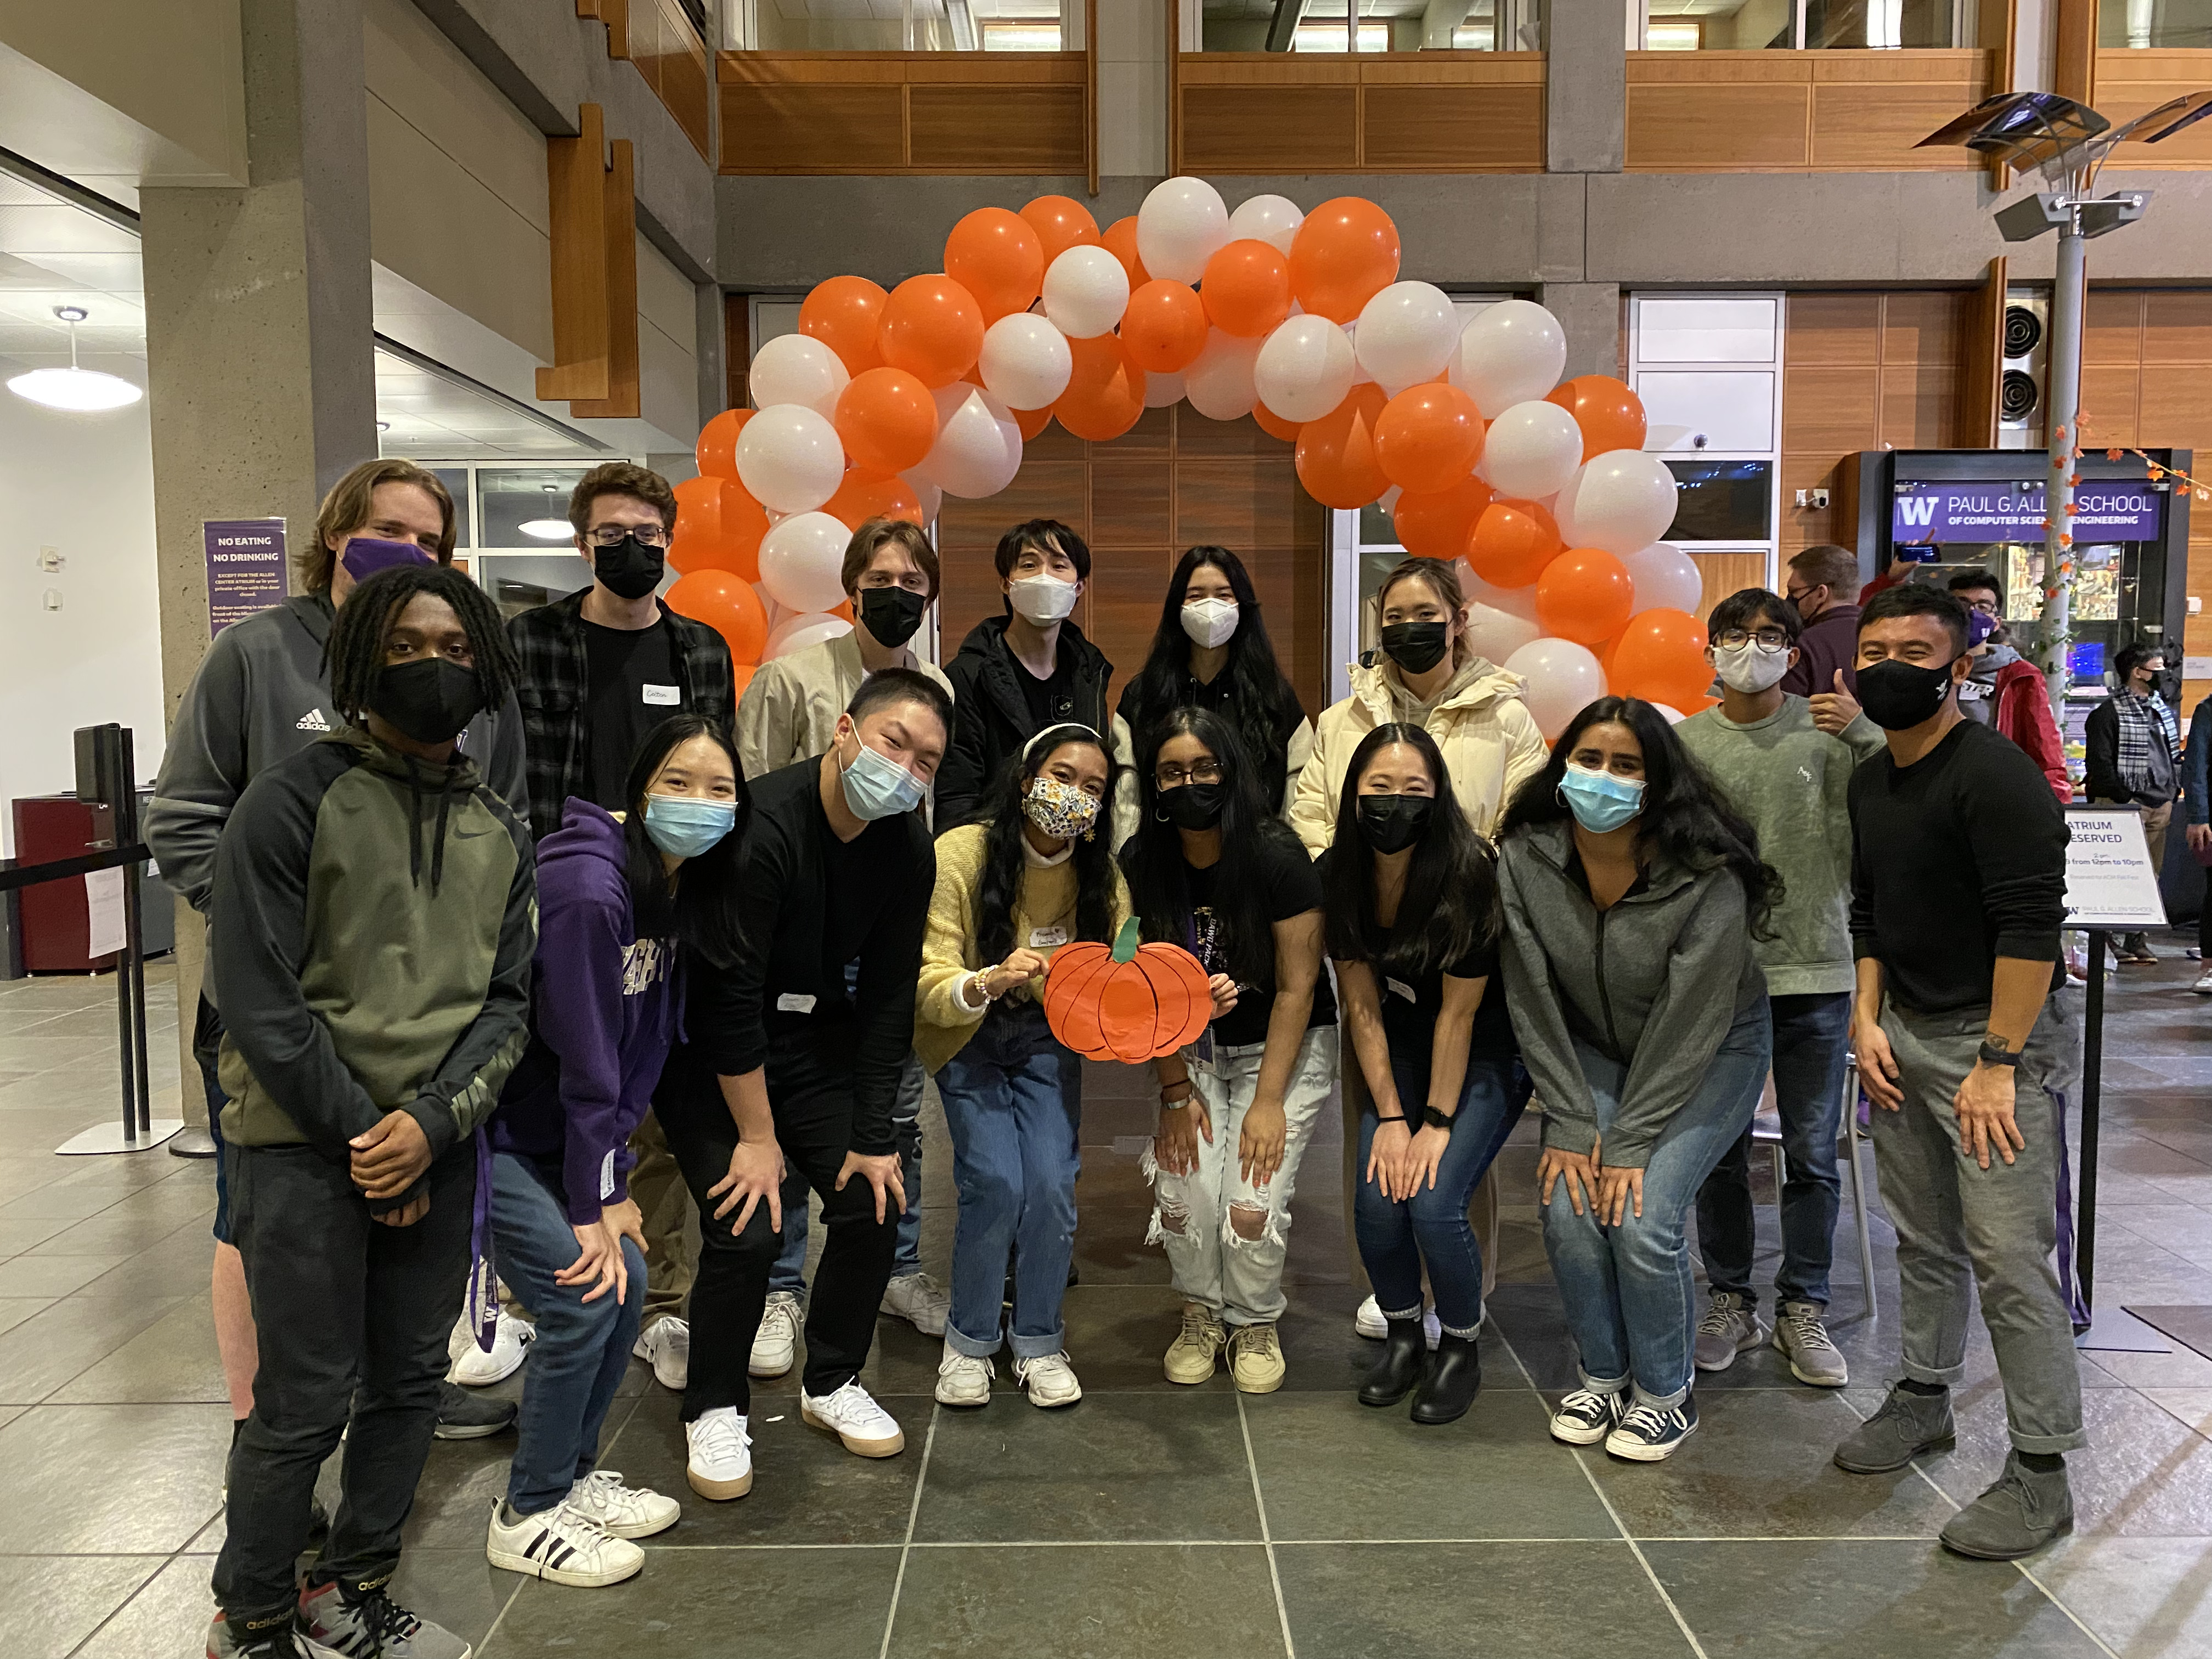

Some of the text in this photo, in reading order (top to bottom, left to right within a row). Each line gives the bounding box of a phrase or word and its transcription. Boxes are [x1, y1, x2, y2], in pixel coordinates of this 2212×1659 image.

[1948, 496, 2153, 512] PAUL G. ALL SCHOOL
[1898, 496, 1939, 526] W
[1948, 516, 1962, 525] OF
[1963, 516, 2019, 525] COMPUTER
[218, 537, 272, 546] NO EATING
[213, 552, 279, 562] NO DRINKING
[1962, 680, 1994, 696] STER
[296, 721, 331, 732] adidas
[2068, 821, 2113, 830] ATRIUM
[2071, 834, 2122, 843] ESERVED
